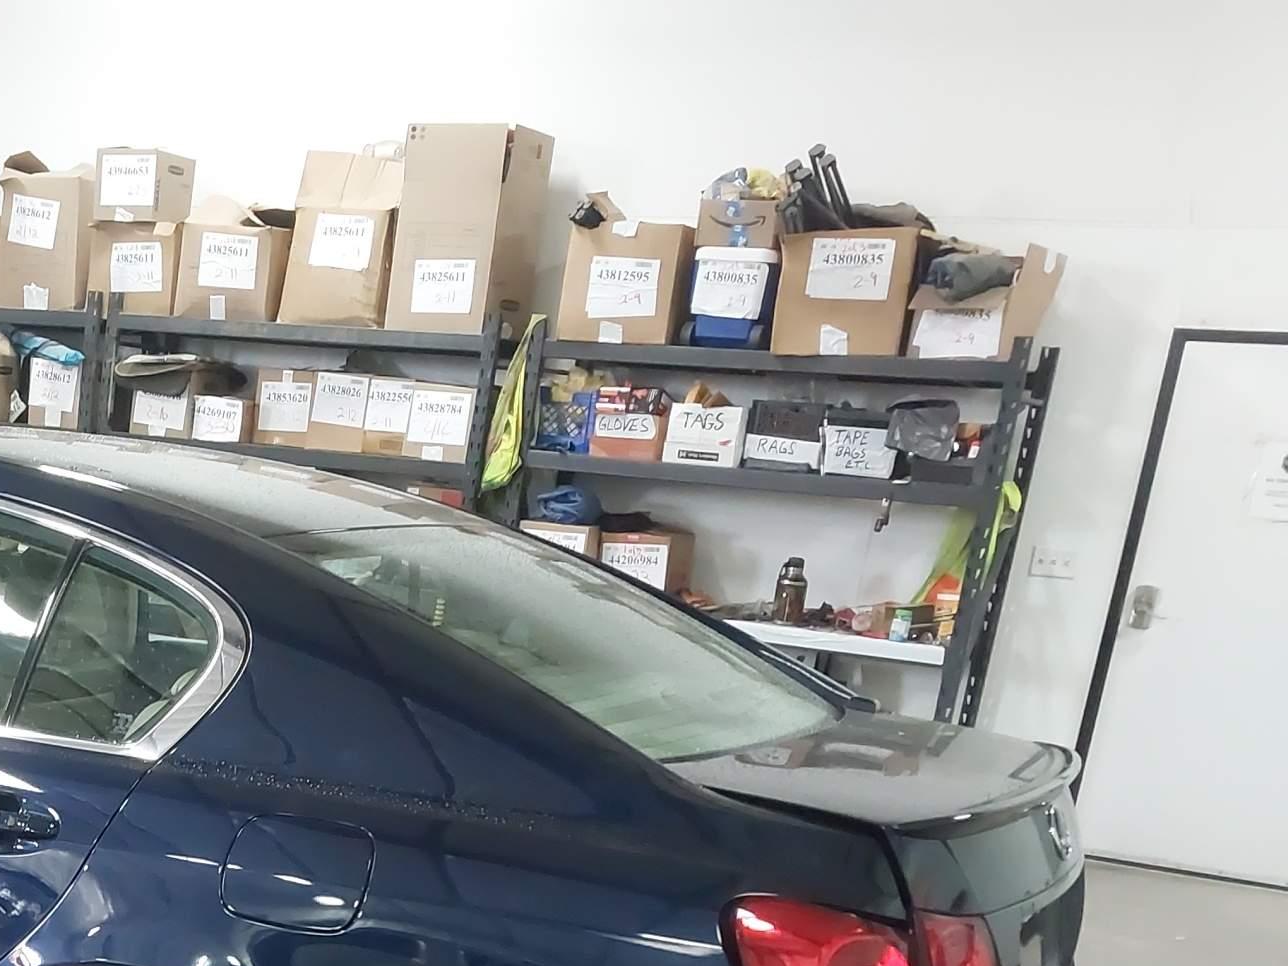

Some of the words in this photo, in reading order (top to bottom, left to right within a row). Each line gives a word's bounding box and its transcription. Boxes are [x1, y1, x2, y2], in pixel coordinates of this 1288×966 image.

[207, 244, 249, 257] 43825611
[116, 253, 154, 263] 43825611
[823, 253, 884, 265] 43800835
[420, 271, 465, 282] 43825611
[597, 269, 650, 282] 43812595
[704, 270, 758, 285] 43800835
[266, 392, 308, 403] 43853620
[321, 384, 361, 398] 43828026
[196, 404, 237, 417] 44269107
[418, 402, 462, 415] 43828784
[599, 416, 649, 433] GLOVES
[683, 411, 726, 431] TAGS
[835, 429, 870, 445] TAPE
[757, 438, 797, 455] RAGS
[835, 446, 866, 458] BAGS
[608, 554, 658, 566] 44206984
